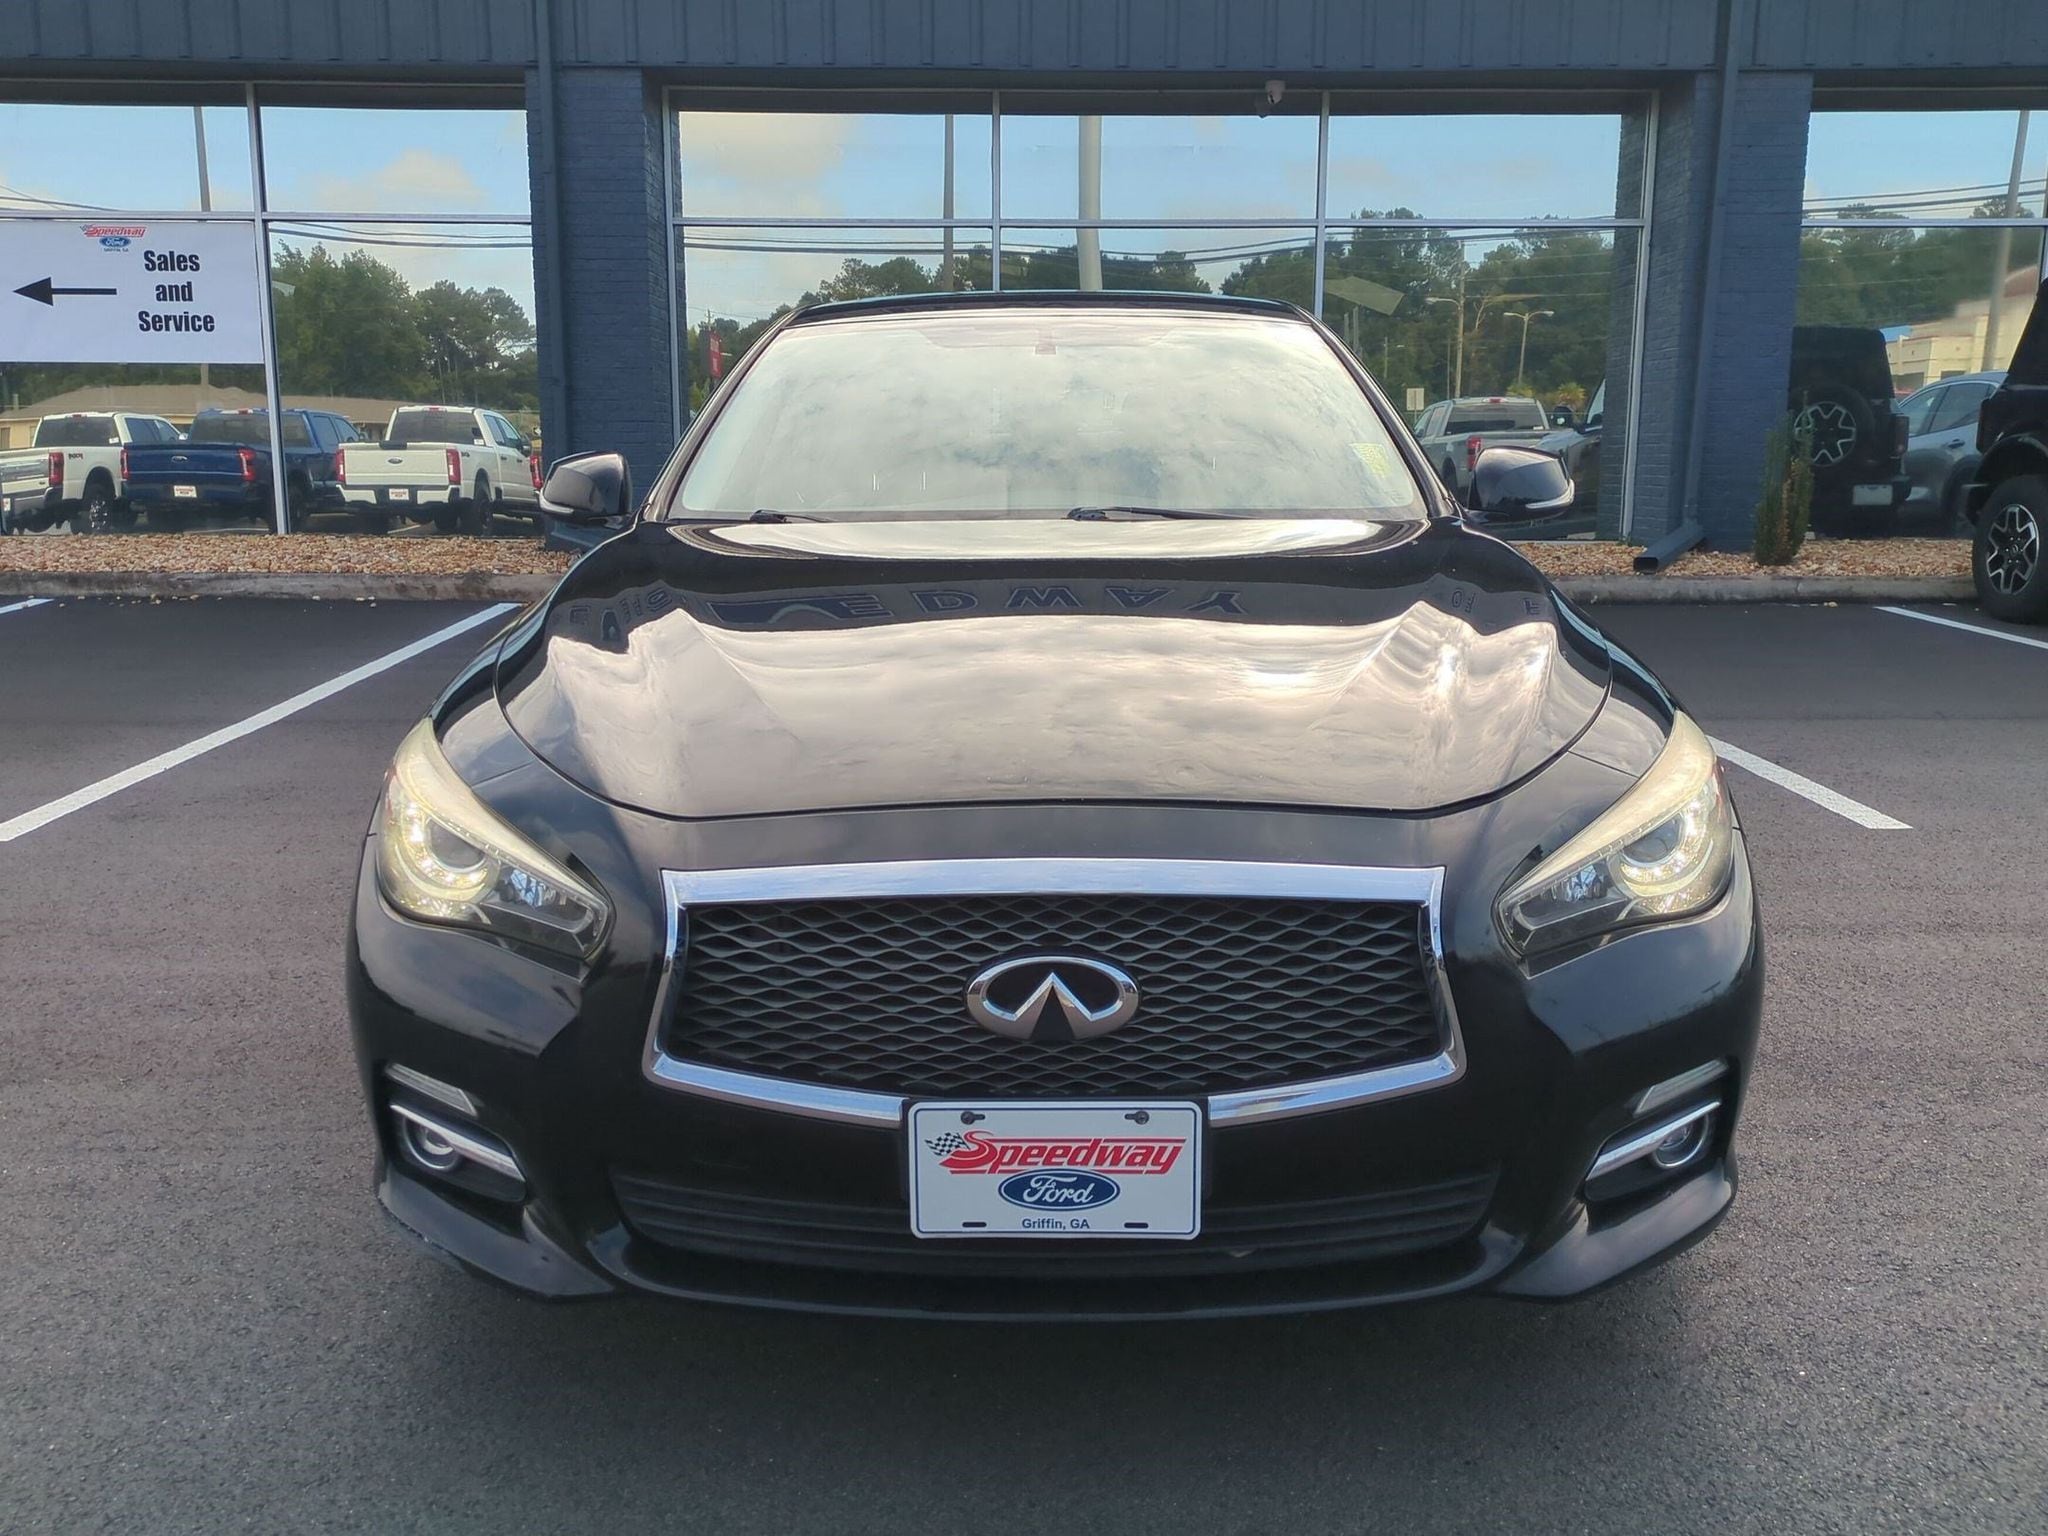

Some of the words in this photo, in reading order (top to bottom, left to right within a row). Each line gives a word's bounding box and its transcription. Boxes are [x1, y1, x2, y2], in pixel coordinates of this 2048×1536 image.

[83, 224, 147, 237] Speedway
[144, 250, 200, 272] Sales
[155, 281, 194, 302] and
[138, 310, 215, 332] Service
[939, 1129, 1185, 1175] Speedway
[1022, 1175, 1095, 1204] Ford
[1021, 1218, 1067, 1230] Griffin,
[1070, 1218, 1090, 1230] GA
